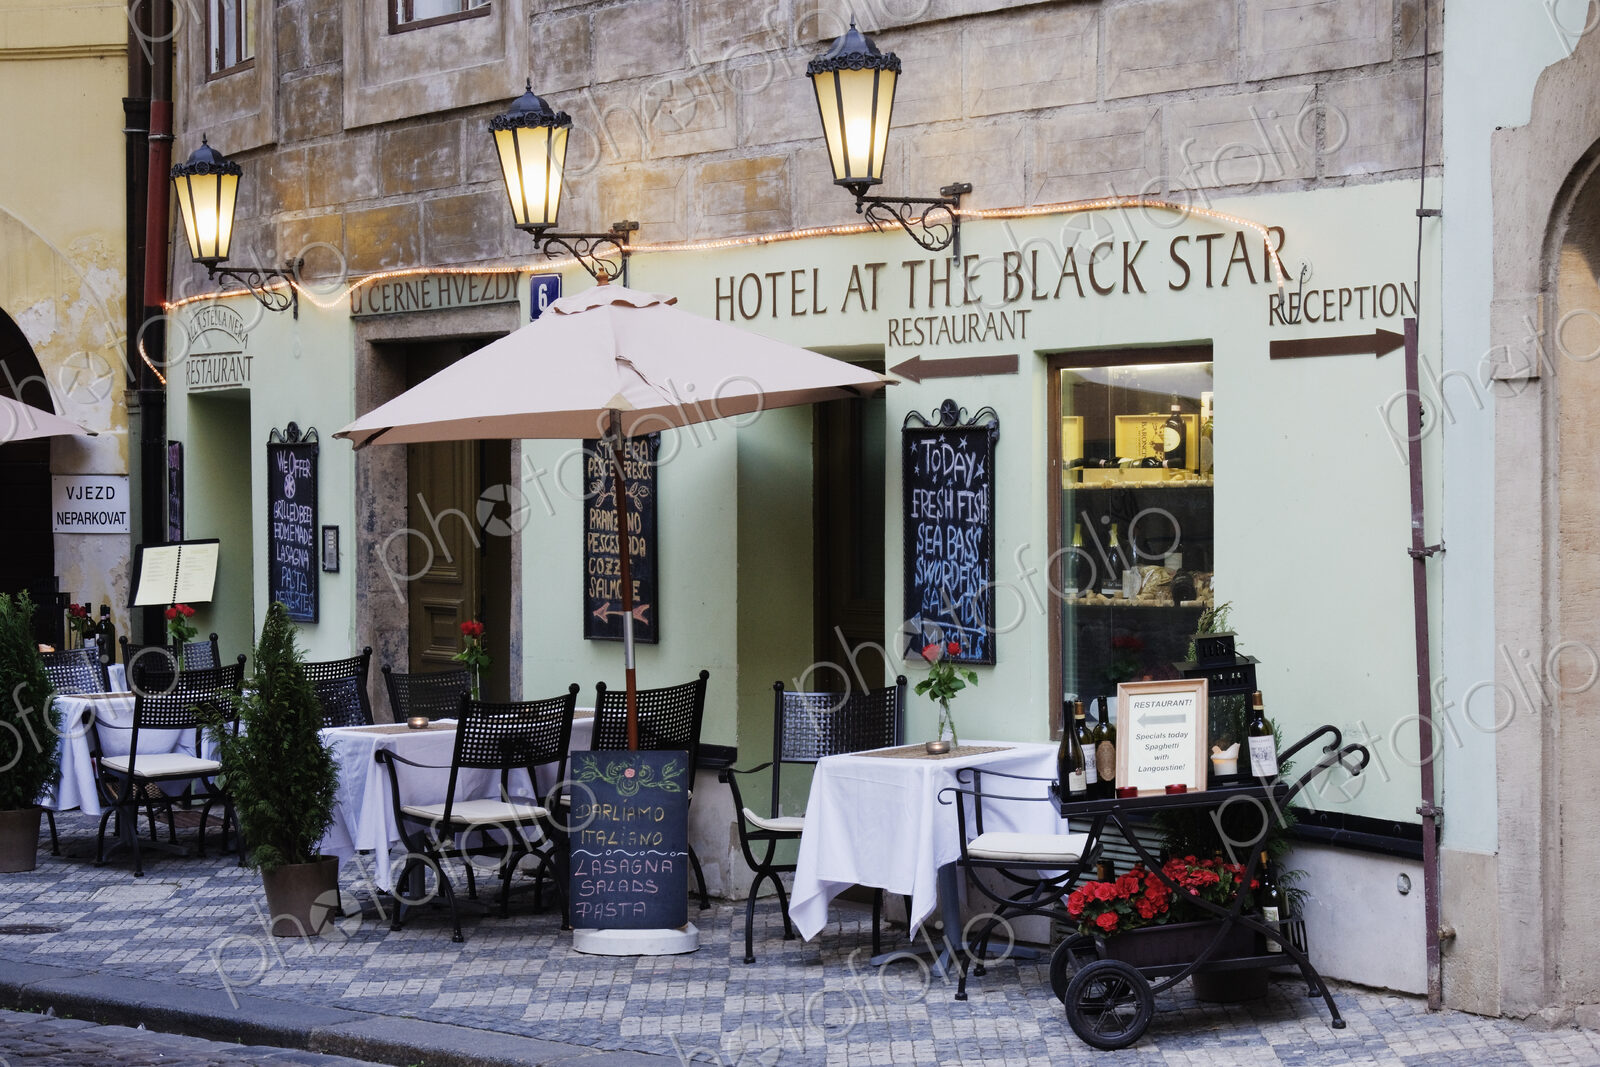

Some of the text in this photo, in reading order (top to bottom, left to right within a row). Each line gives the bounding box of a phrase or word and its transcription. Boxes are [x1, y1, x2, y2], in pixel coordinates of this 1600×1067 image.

[715, 226, 1293, 321] HOTEL AT THE BLACK STAR
[350, 285, 362, 314] U
[538, 283, 548, 312] 6
[1269, 281, 1418, 326] RECEPTION
[888, 309, 1032, 347] RESTAURANT
[186, 355, 254, 386] RESTAURANT
[596, 440, 649, 461] STERA
[588, 457, 616, 478] PESCE
[66, 486, 115, 500] VJEZD
[911, 483, 988, 525] FRESH FISH
[57, 511, 126, 525] NEPARKOVAT
[274, 500, 299, 522] GRILLED
[589, 508, 642, 534] BRANZNO
[274, 522, 312, 546] HOMEMADE
[917, 523, 983, 563] SEA BASS
[277, 541, 309, 571] LASAGNA
[588, 557, 633, 576] COZZ
[281, 566, 307, 593] PASTA
[589, 577, 640, 601] SALMOE
[915, 554, 988, 602] SWORDFISH
[1134, 699, 1192, 709] RESTAURANT!
[1136, 731, 1188, 740] Specials today
[1145, 742, 1179, 751] Spaghetti
[1138, 764, 1186, 773] Langoustine!
[574, 859, 673, 876] LASAGNA
[579, 880, 658, 897] SALADS
[576, 902, 646, 919] PASTA
